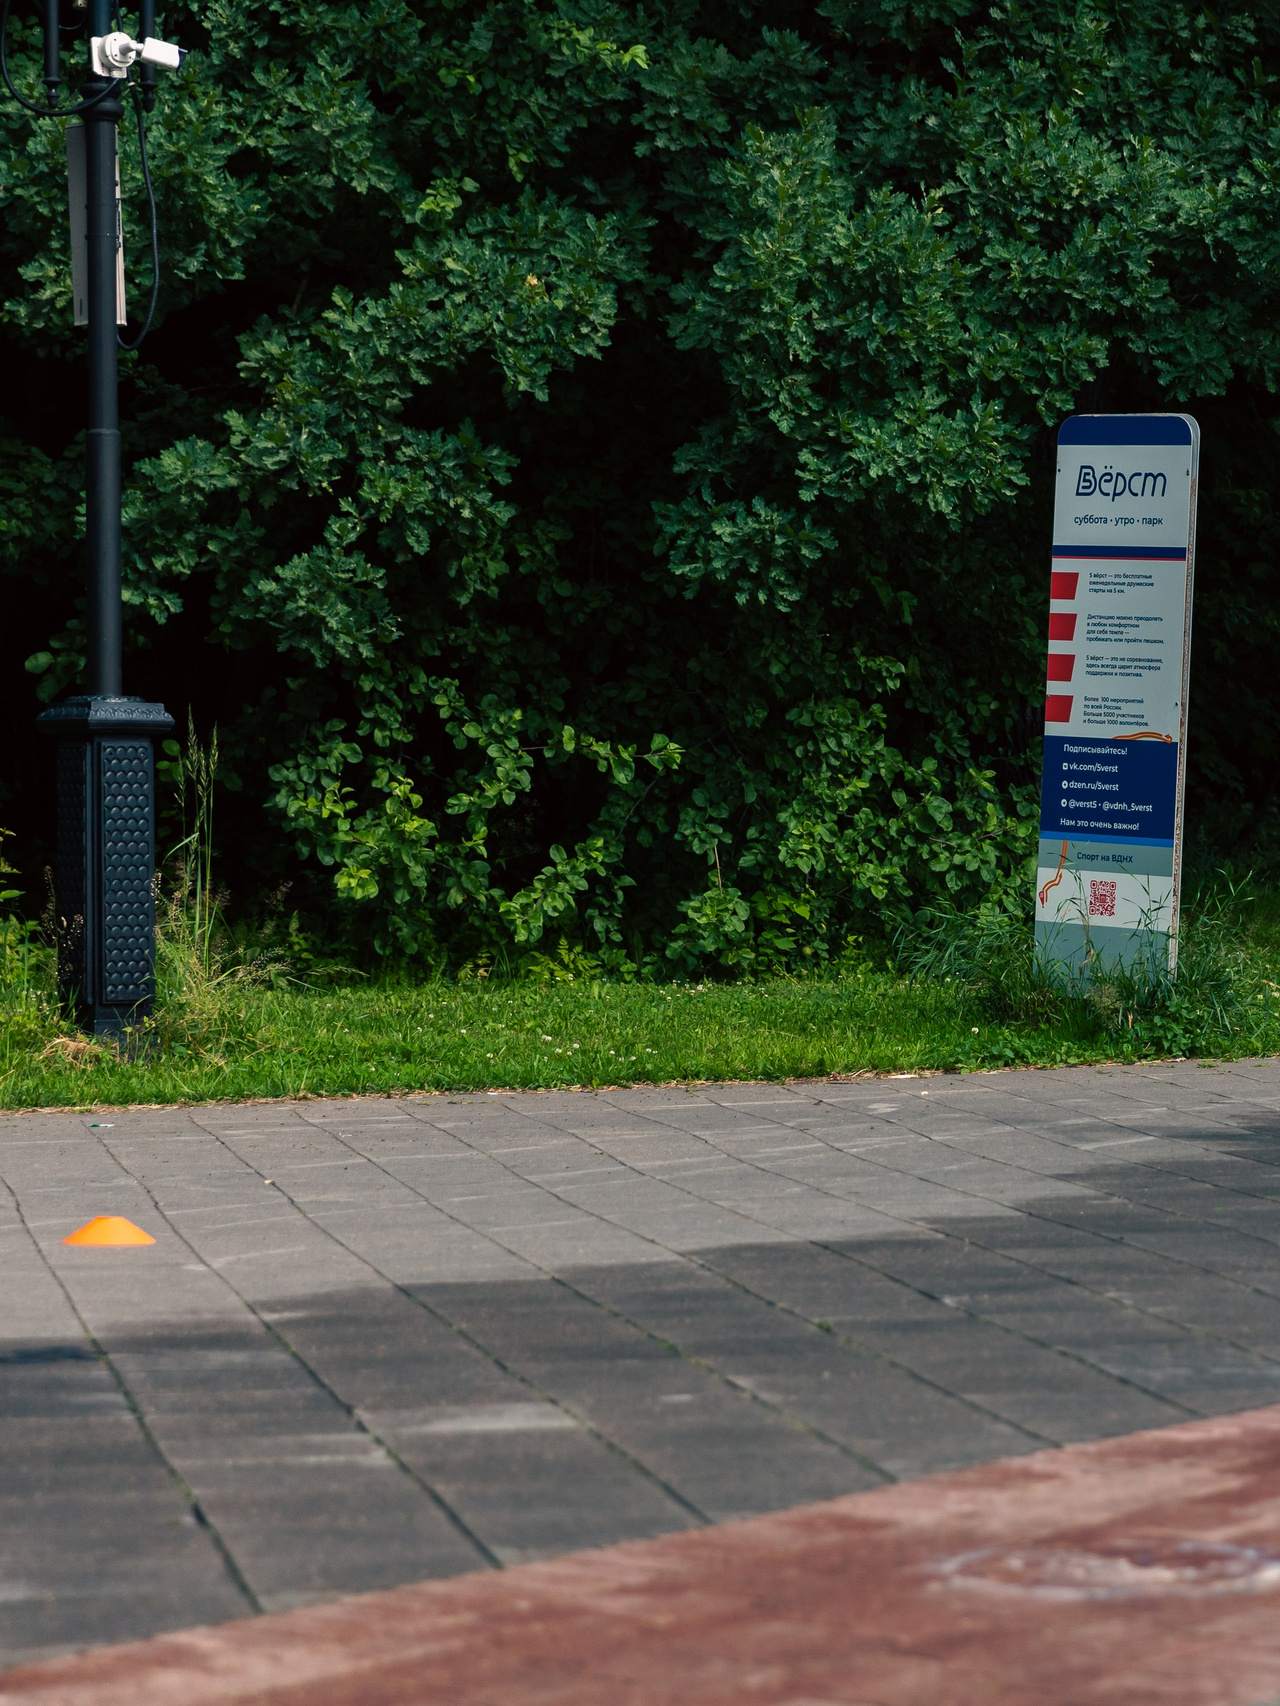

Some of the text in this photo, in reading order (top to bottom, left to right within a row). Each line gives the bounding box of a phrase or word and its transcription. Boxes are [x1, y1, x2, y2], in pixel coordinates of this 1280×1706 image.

[1074, 515, 1163, 526] суббота утро парк
[1064, 744, 1127, 755] Подписывайтесь!
[1069, 763, 1118, 772] vk.com/5verst
[1069, 780, 1118, 791] dzen.ru/5verst
[1069, 799, 1152, 812] @verst5 @vdnh_5verst
[1077, 852, 1099, 862] Спорт
[1112, 854, 1133, 863] ВДНХ
